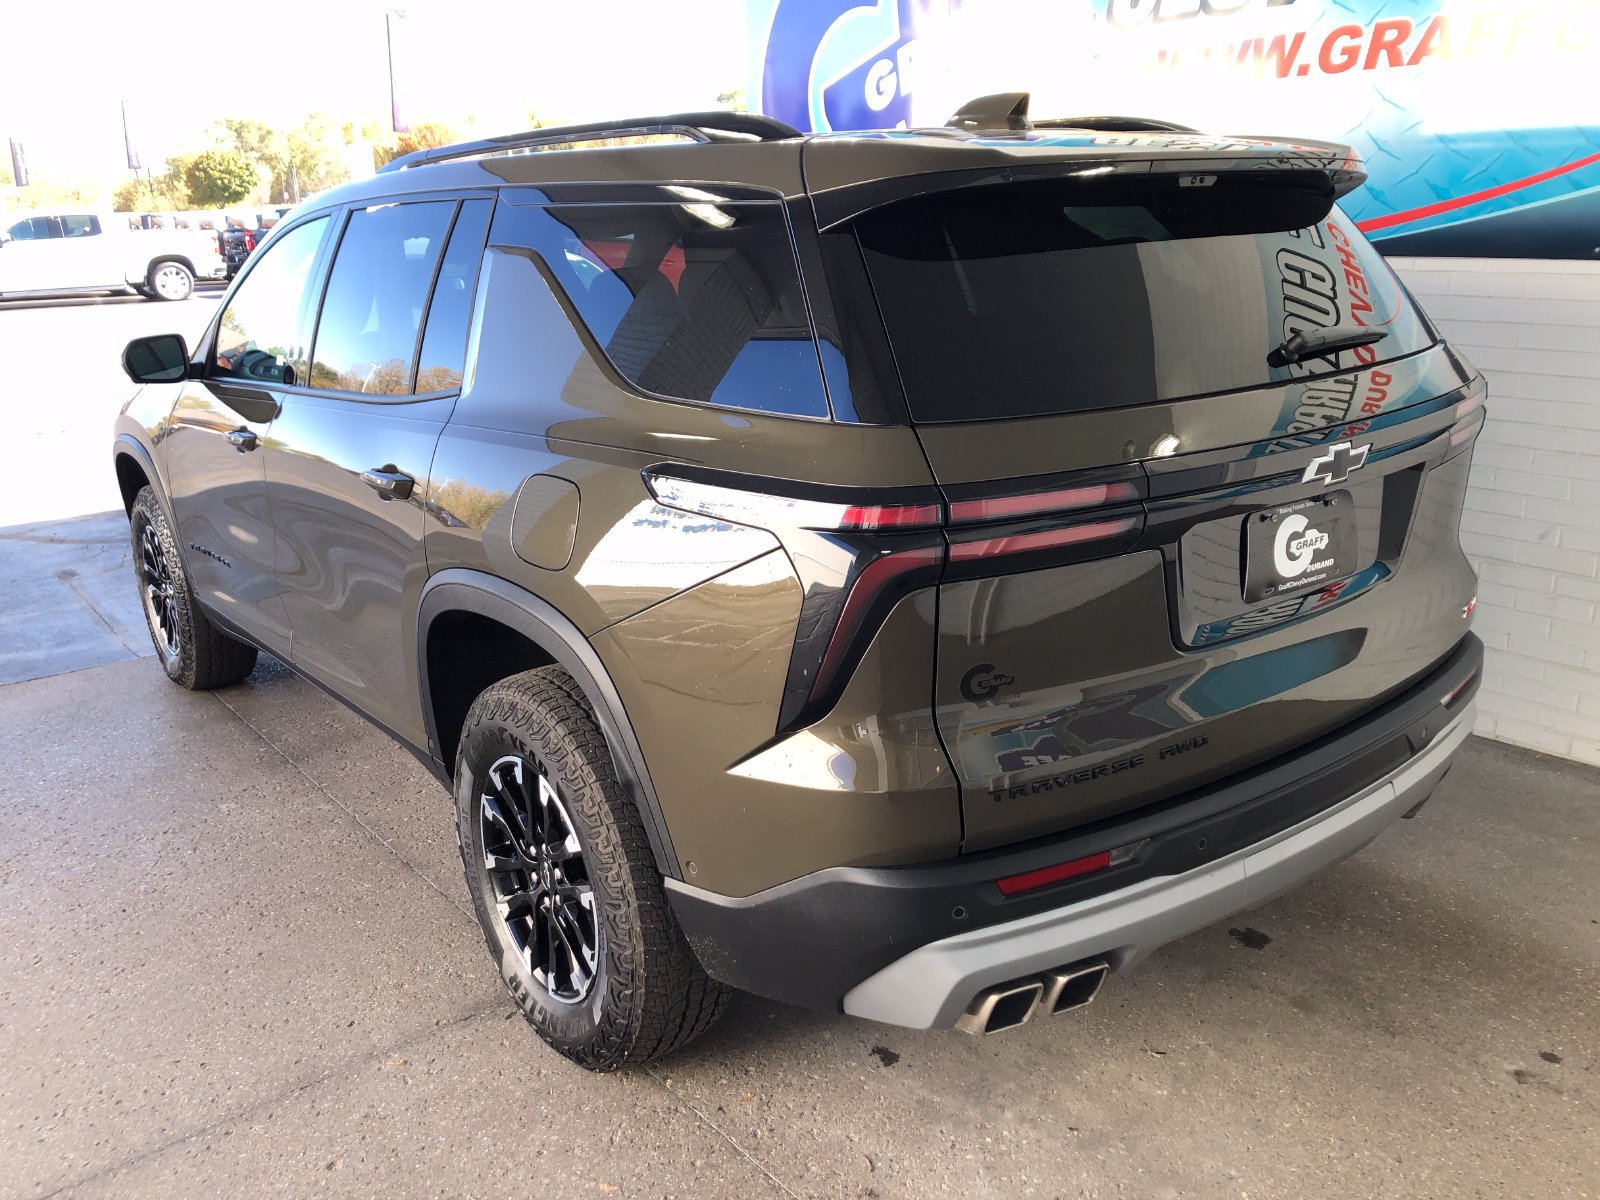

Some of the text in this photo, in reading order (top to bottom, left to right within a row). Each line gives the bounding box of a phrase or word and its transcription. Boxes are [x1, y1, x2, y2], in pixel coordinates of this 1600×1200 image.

[1295, 535, 1326, 551] GRAFF
[1306, 558, 1335, 573] DURAND
[988, 735, 1209, 802] TRAVERSE AWD
